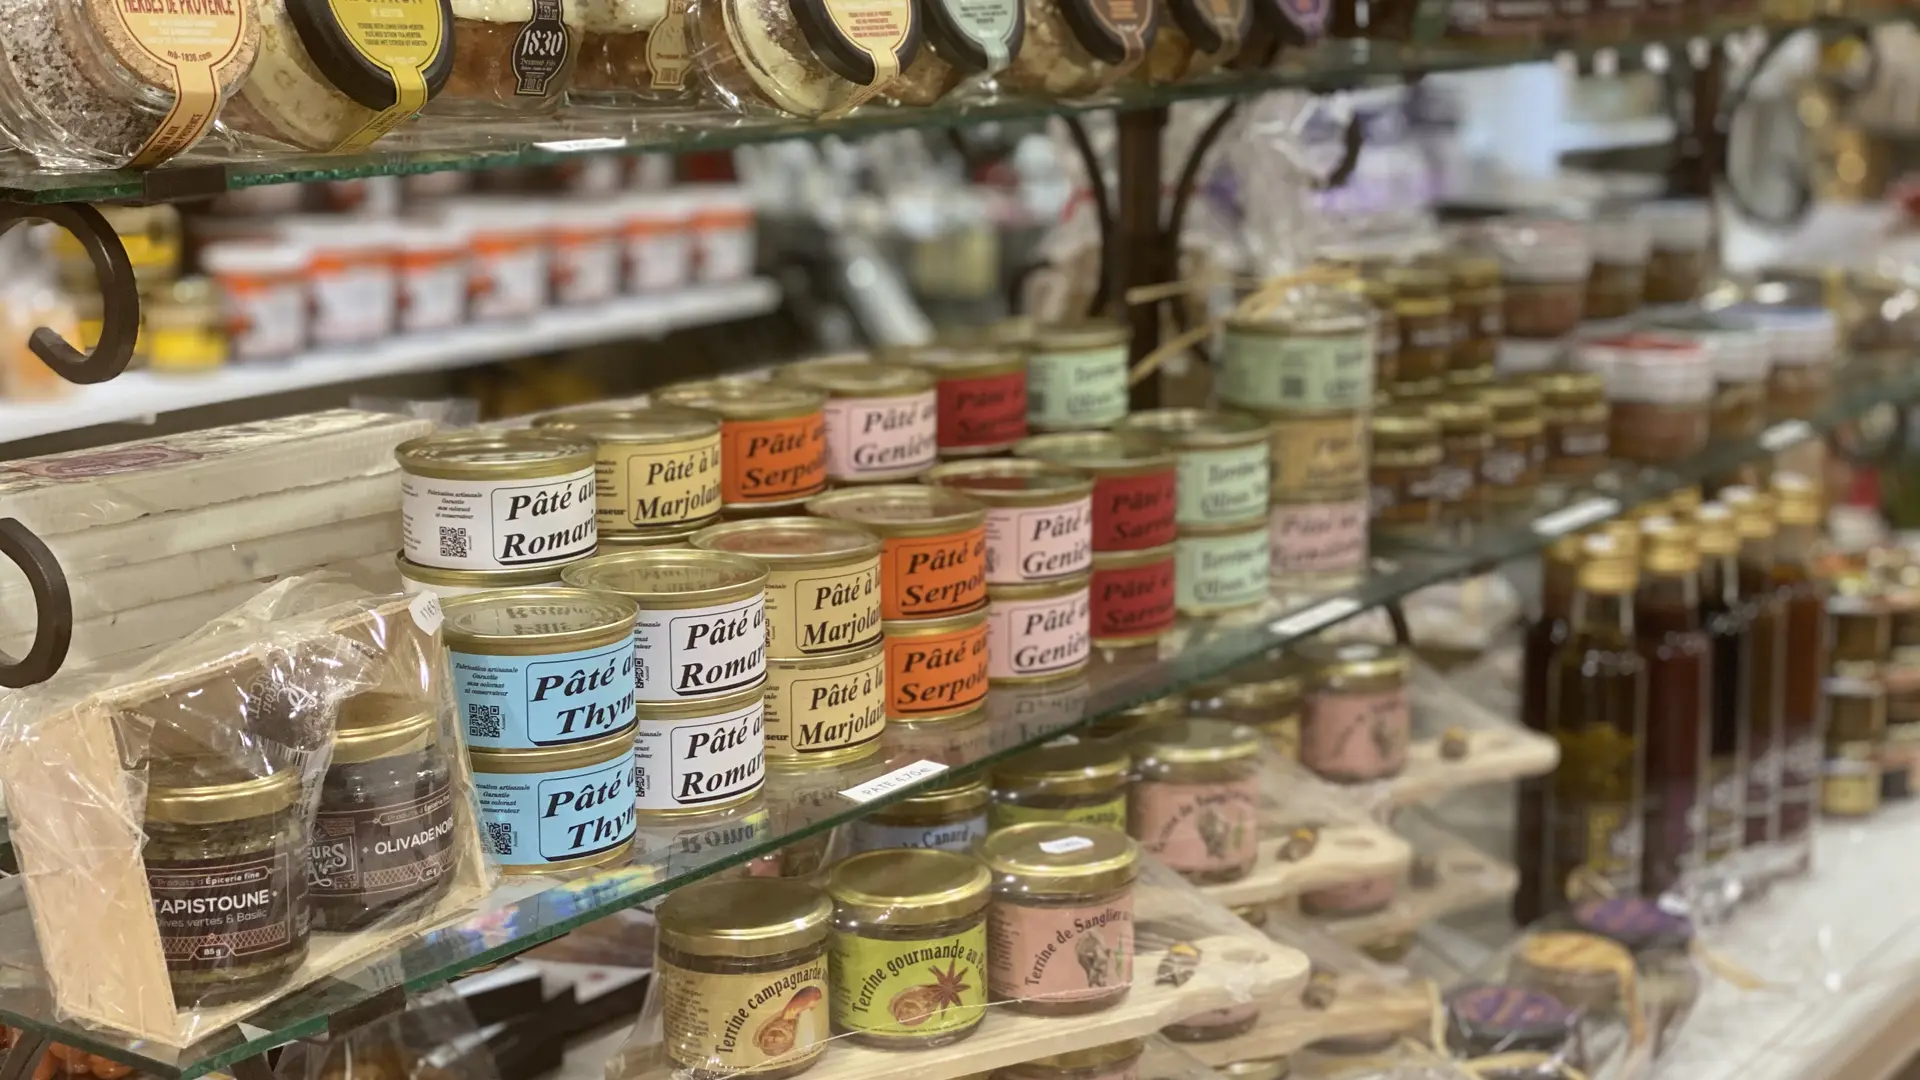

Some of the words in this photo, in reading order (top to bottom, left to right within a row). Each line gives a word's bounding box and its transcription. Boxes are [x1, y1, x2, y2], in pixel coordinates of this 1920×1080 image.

[521, 30, 563, 56] 1830
[747, 424, 806, 458] Pâté
[646, 455, 694, 486] Pâté
[699, 451, 707, 473] à
[505, 483, 572, 521] Pâté
[905, 541, 968, 575] Pâté
[813, 577, 860, 610] Pâté
[865, 572, 872, 596] à
[683, 609, 748, 650] Pâté
[901, 640, 966, 673] Pâté
[529, 657, 616, 702] Pâté
[808, 677, 859, 711] Pâté
[863, 672, 871, 696] à
[684, 717, 748, 759] Pâté
[541, 770, 622, 819] Pâté
[922, 825, 969, 848] Canard
[244, 871, 260, 880] fine
[187, 915, 223, 927] vertes
[226, 915, 234, 924] &
[237, 909, 267, 922] Basilic
[215, 948, 221, 956] g
[1025, 943, 1057, 986] Terrine
[1056, 930, 1073, 945] de
[1073, 907, 1123, 933] Sanglier
[852, 967, 887, 1014] Terrine
[886, 938, 965, 977] gourmande
[714, 1007, 750, 1055] Terrine
[748, 960, 822, 1010] campagnarde
